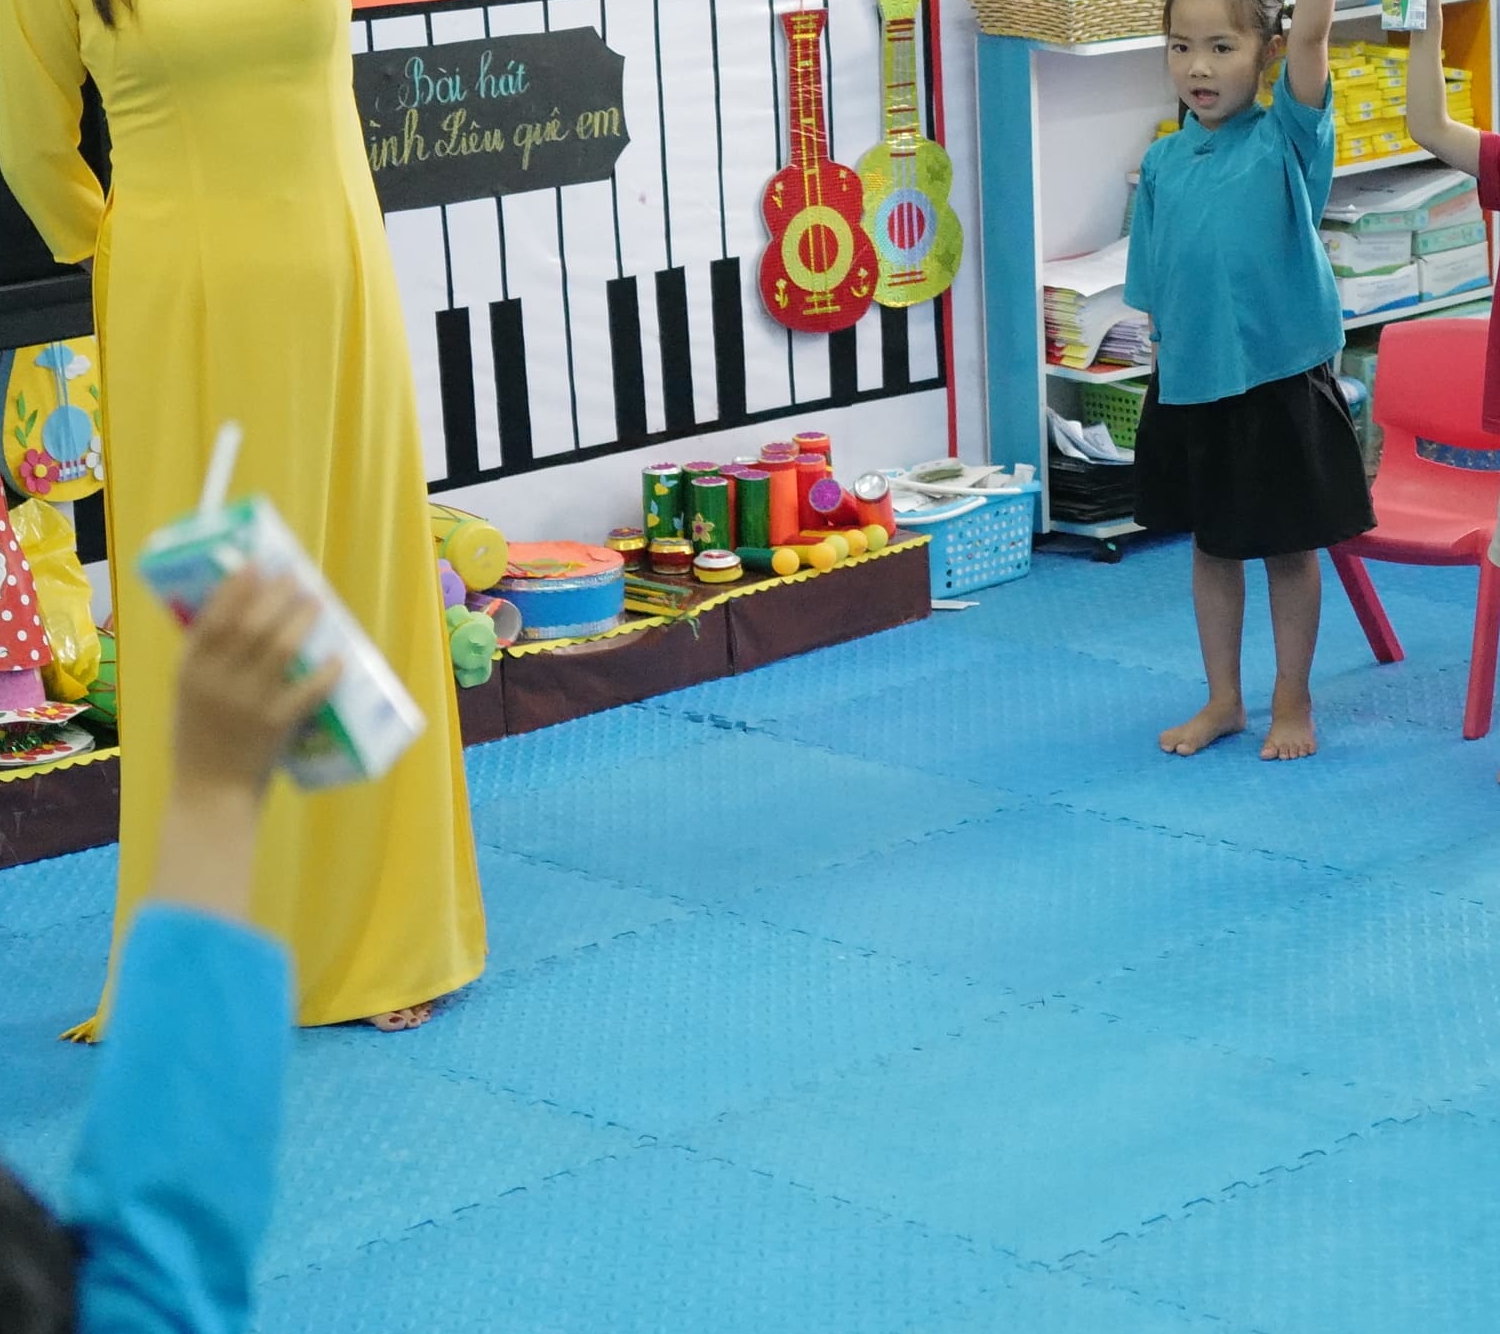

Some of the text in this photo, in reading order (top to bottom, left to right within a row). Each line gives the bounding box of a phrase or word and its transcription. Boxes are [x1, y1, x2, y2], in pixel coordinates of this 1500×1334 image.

[396, 50, 530, 110] Bài hát
[369, 106, 621, 172] ình Liêu quê em
